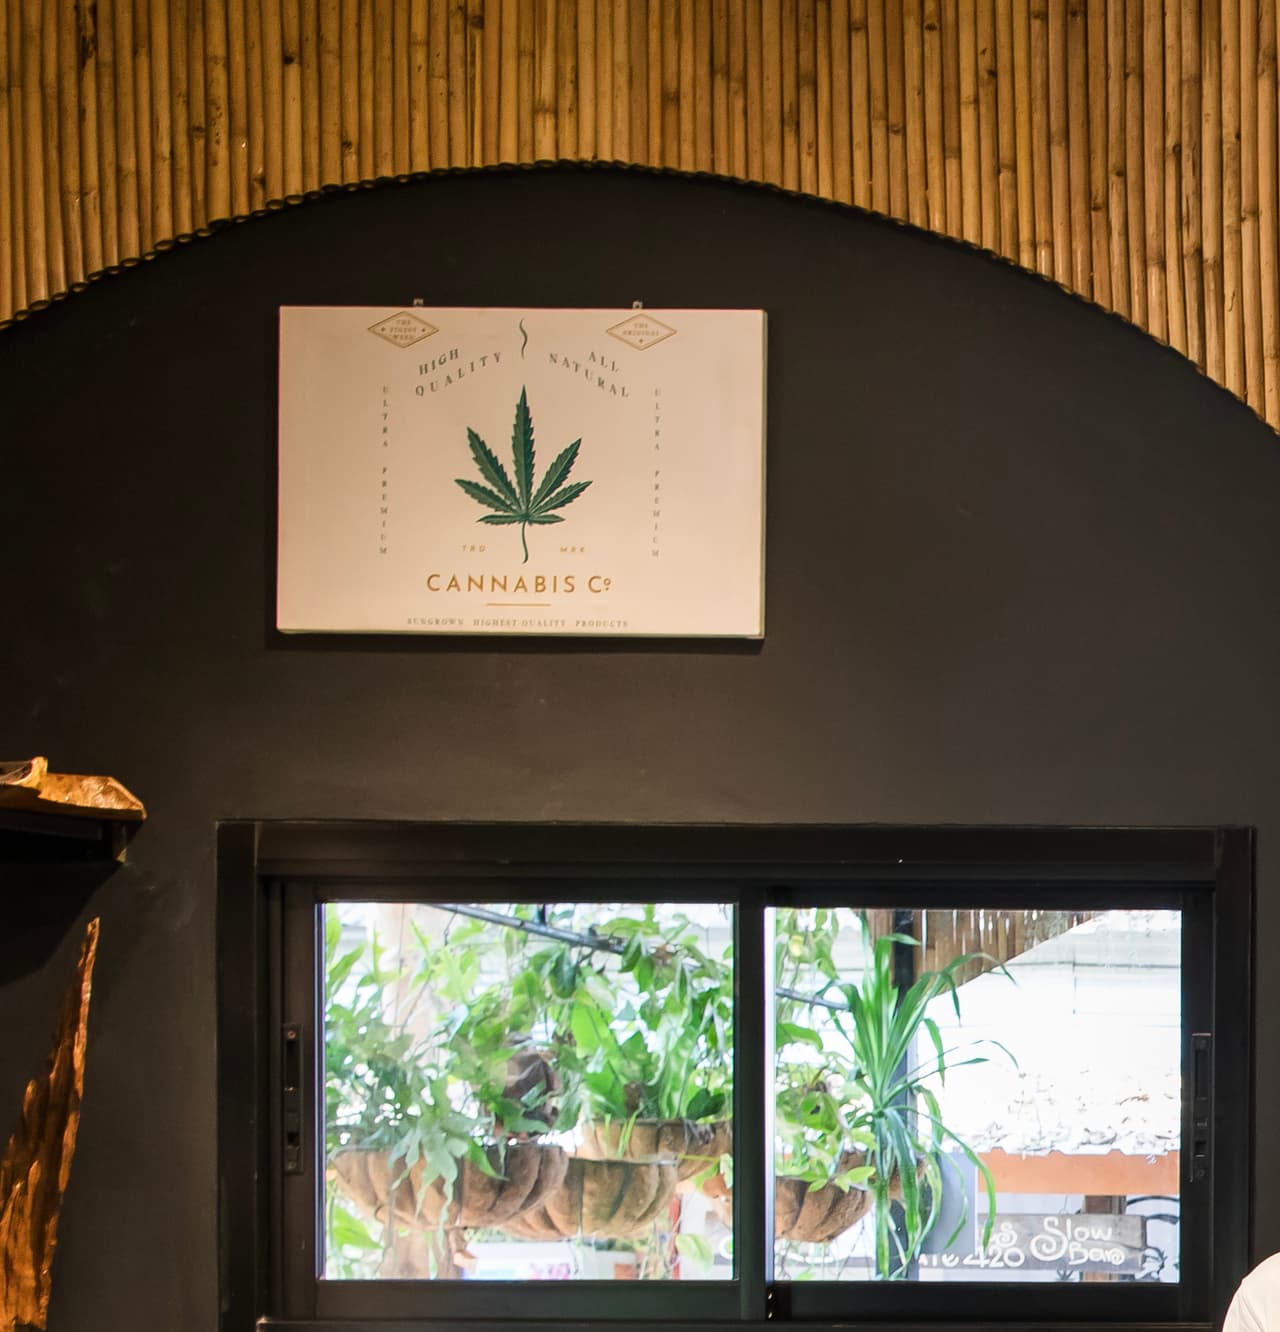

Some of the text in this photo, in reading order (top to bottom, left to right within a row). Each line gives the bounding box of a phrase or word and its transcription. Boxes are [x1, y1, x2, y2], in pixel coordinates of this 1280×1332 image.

[418, 348, 460, 376] HIGH
[588, 351, 621, 372] ALL
[415, 352, 502, 396] QUALITY
[549, 353, 629, 398] NATURAL
[426, 574, 576, 593] CANNABIS
[575, 620, 628, 628] PRODUCTS
